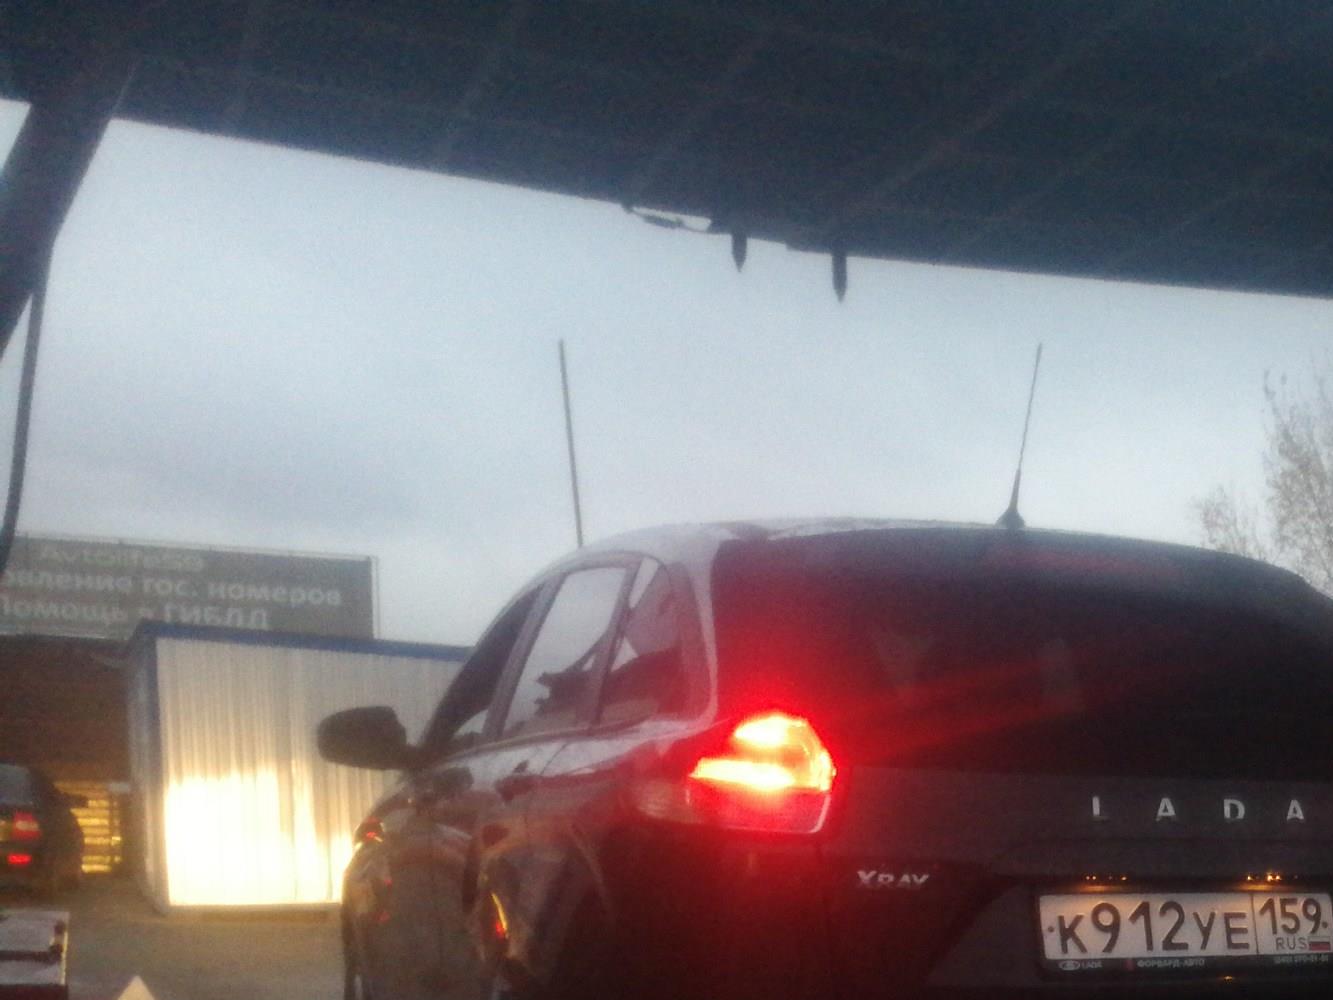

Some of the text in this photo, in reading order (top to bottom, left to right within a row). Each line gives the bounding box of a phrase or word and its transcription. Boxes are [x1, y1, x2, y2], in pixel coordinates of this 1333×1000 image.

[143, 577, 199, 598] гос.
[207, 583, 341, 608] номеров
[1092, 795, 1305, 822] LADA
[1057, 897, 1322, 954] К912УЕ 159
[1275, 936, 1307, 951] RUS
